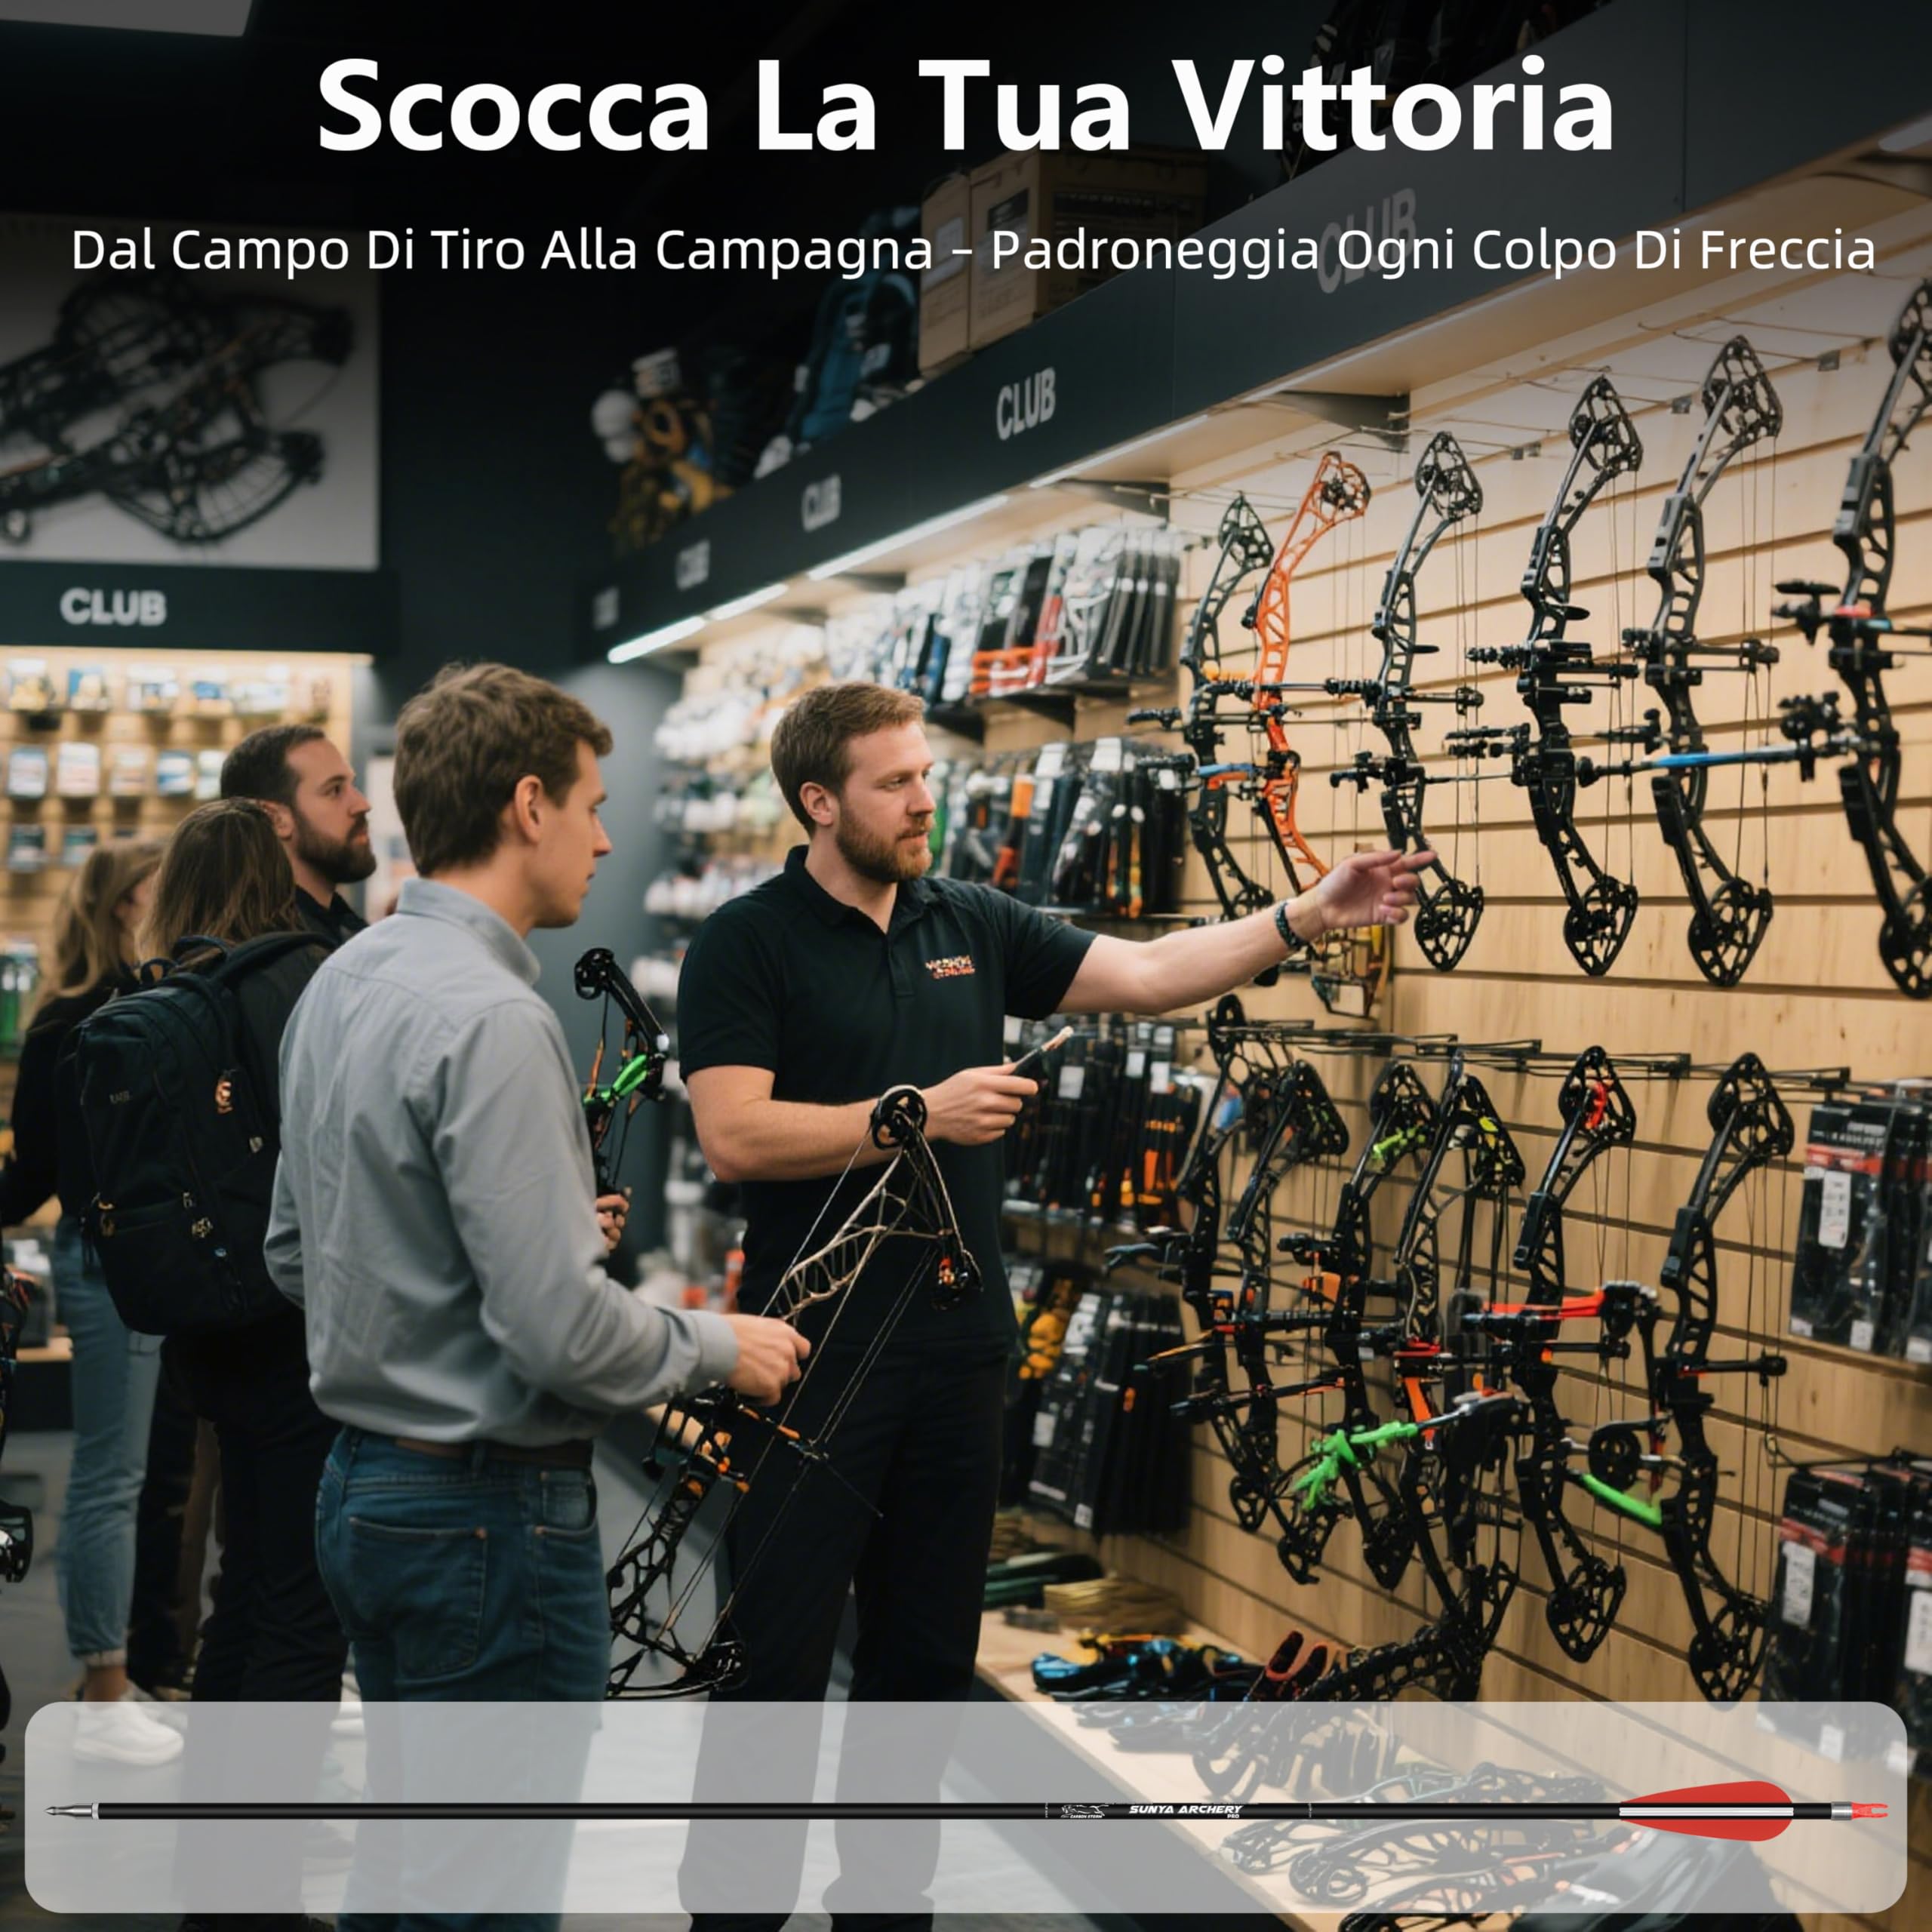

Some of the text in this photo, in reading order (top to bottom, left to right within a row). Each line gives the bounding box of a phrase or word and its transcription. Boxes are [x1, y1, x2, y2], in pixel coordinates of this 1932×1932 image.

[1318, 188, 1417, 294] CLUB
[997, 367, 1057, 440] CLUB
[60, 587, 167, 626] CLUB
[1129, 1805, 1244, 1814] SUNYA ARCHERY
